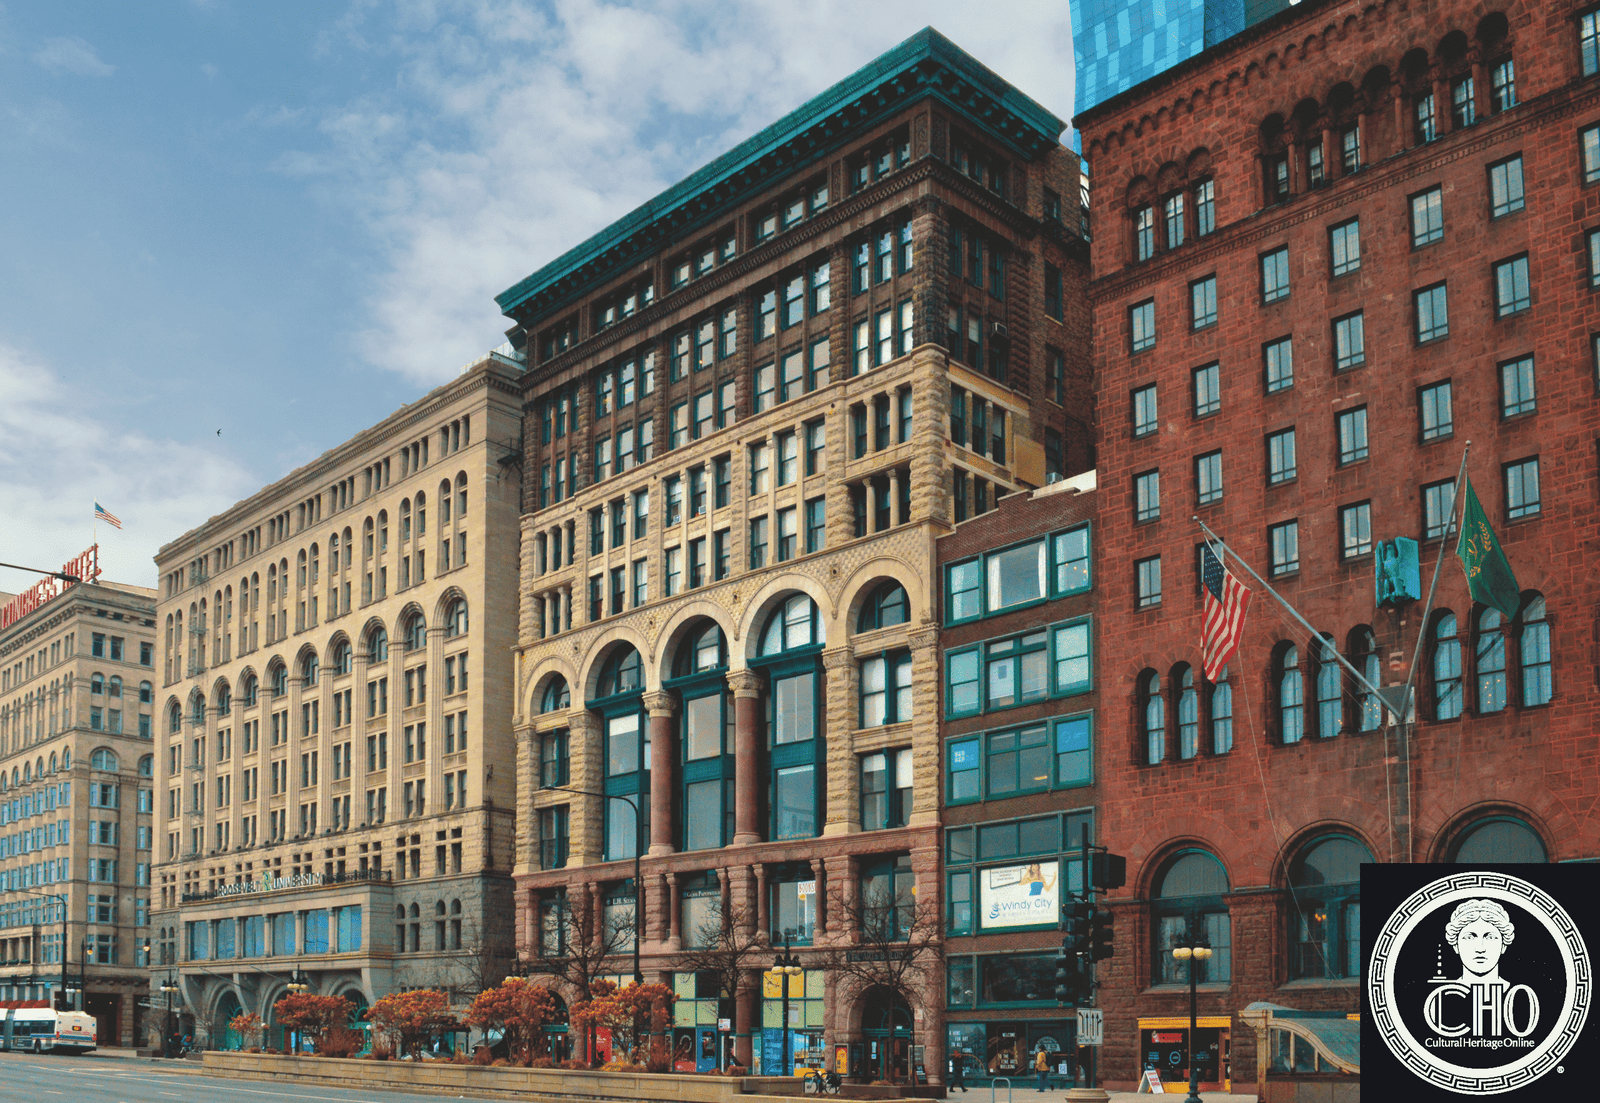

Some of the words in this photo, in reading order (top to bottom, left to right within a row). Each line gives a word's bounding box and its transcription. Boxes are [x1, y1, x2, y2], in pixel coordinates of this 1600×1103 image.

[219, 881, 260, 896] ROOSEVELT
[273, 872, 321, 890] UNIVERSITY
[1001, 900, 1032, 910] Windy
[1034, 898, 1052, 908] City
